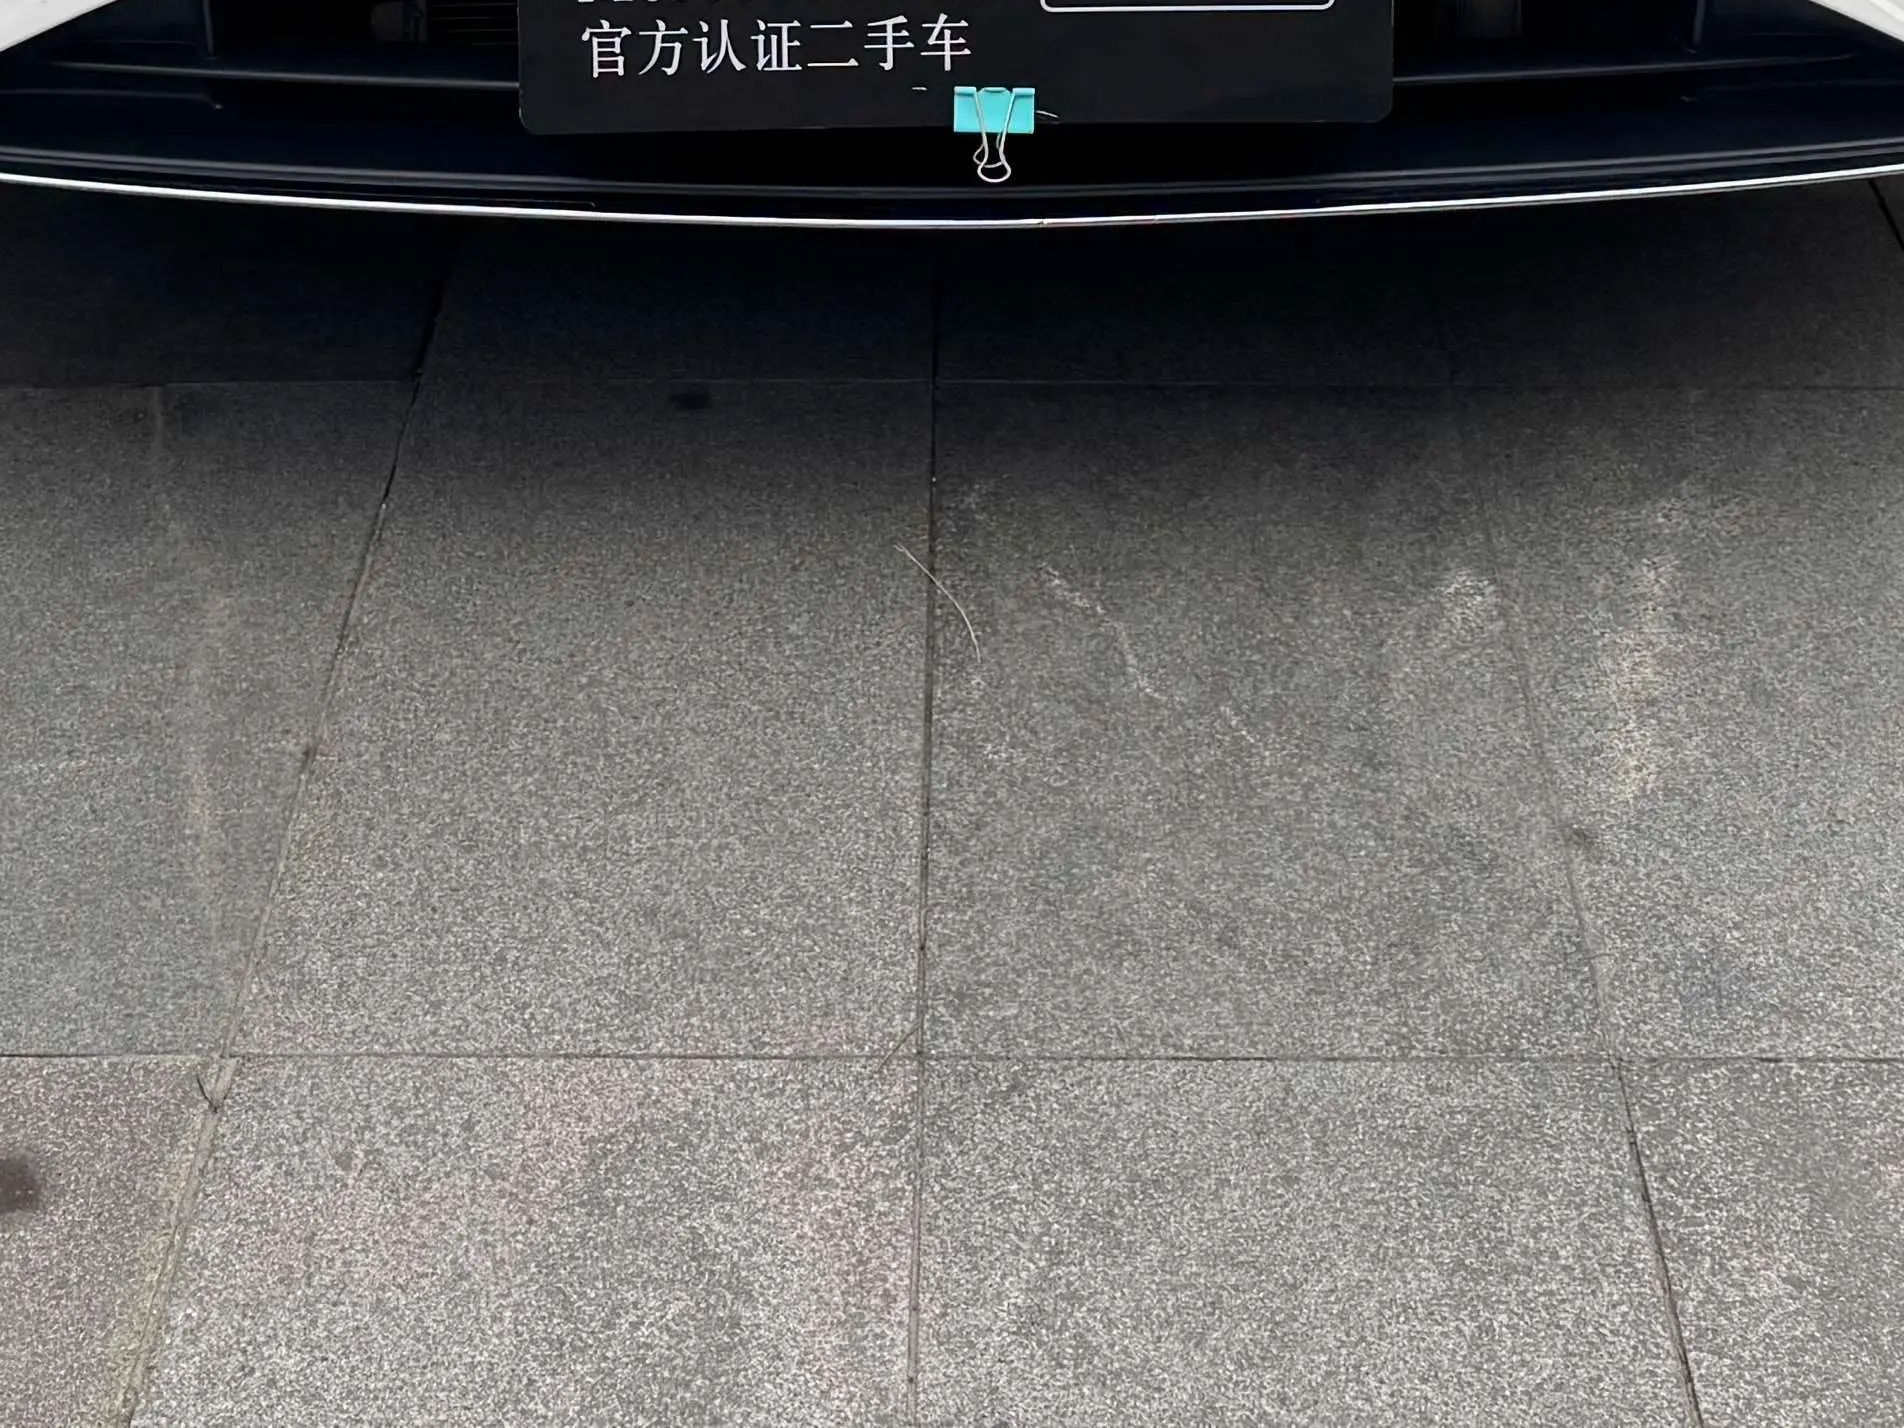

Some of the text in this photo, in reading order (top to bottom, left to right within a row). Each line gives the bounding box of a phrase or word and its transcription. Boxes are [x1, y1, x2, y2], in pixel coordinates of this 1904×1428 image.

[580, 12, 973, 80] 官方认证二手车
